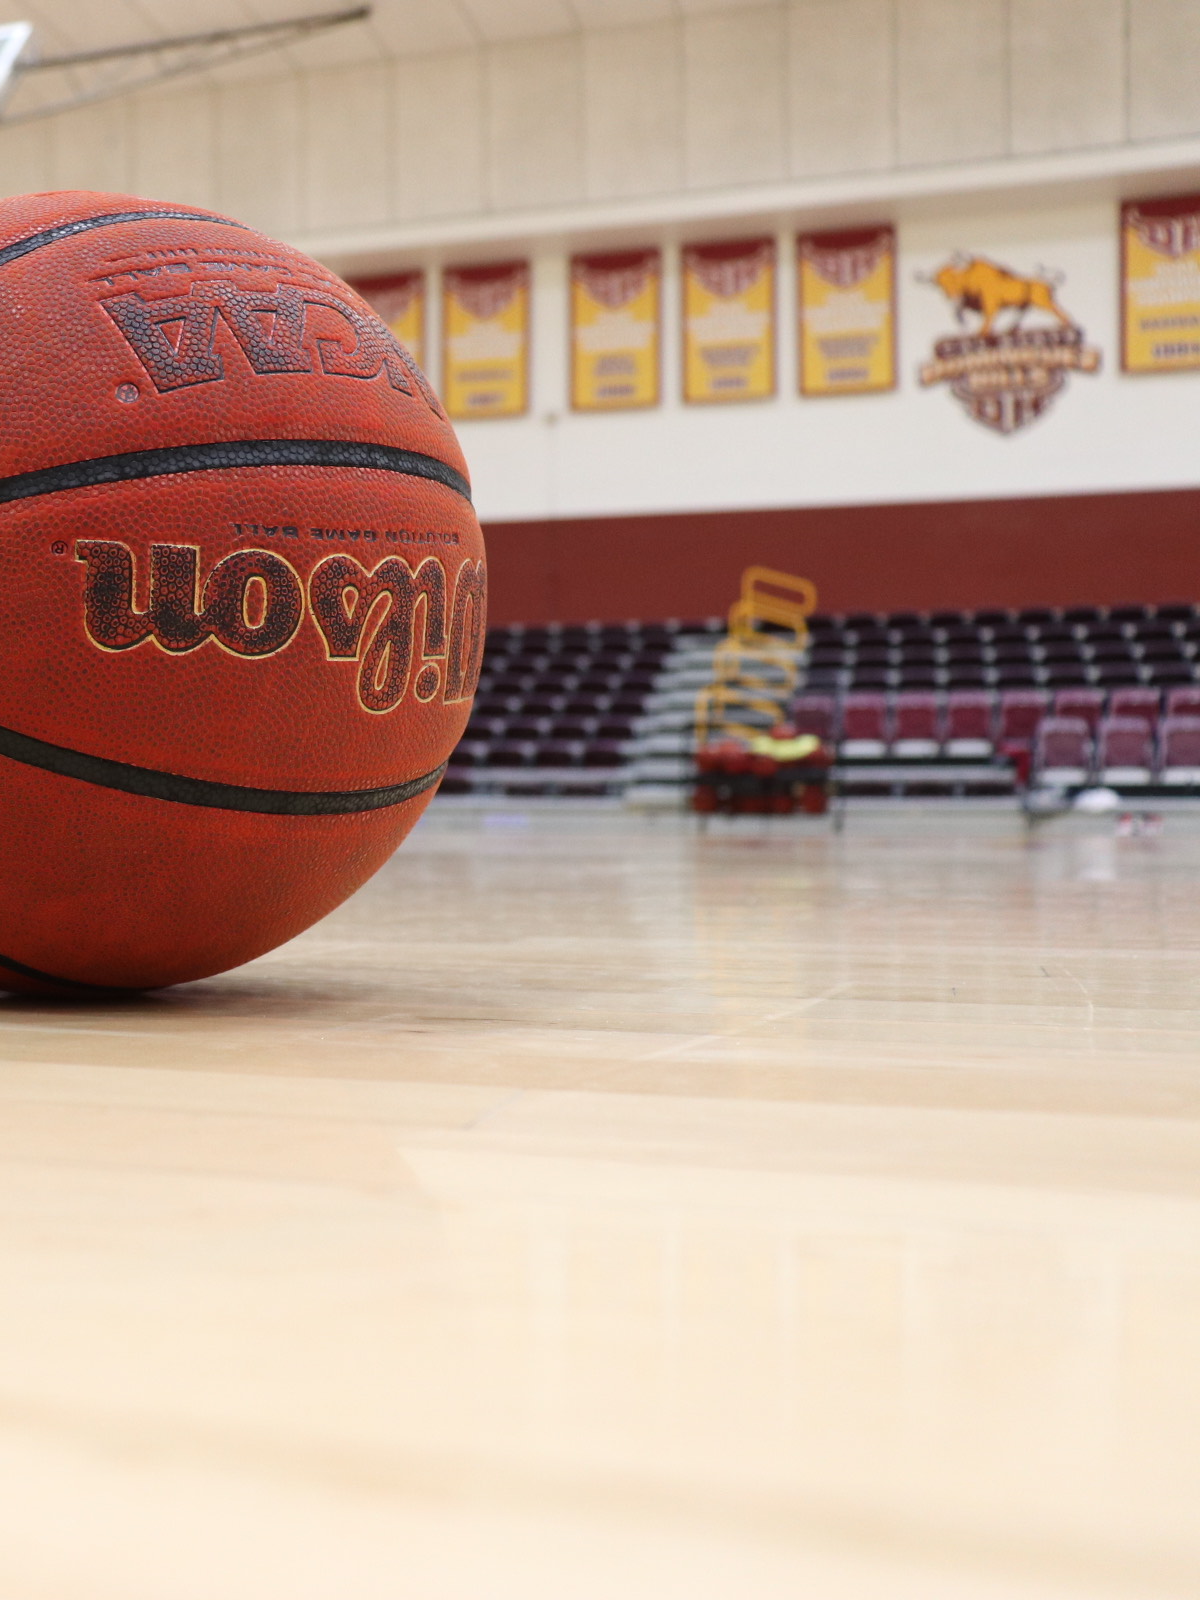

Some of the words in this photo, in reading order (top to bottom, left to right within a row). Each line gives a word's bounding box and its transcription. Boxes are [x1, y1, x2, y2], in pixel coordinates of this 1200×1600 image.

[230, 522, 299, 538] BALL
[309, 527, 377, 544] GAME
[385, 530, 460, 546] SOLUTION
